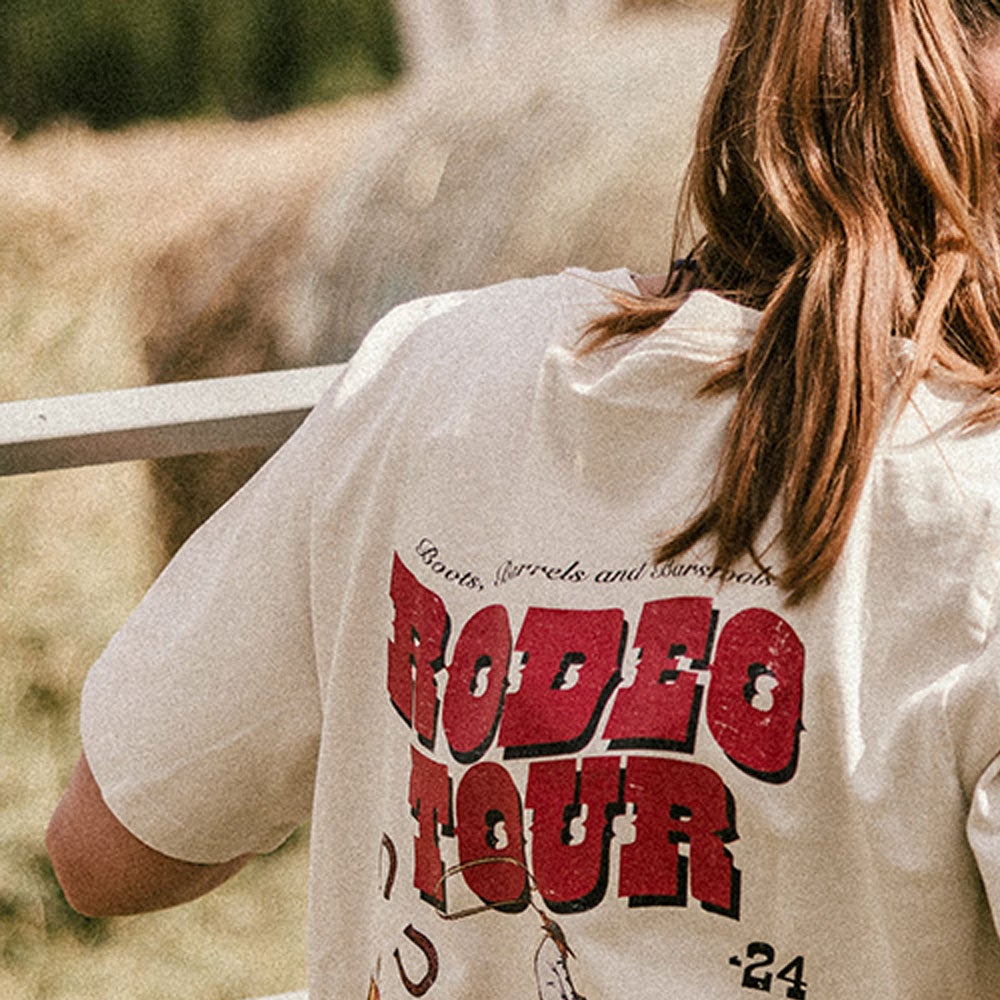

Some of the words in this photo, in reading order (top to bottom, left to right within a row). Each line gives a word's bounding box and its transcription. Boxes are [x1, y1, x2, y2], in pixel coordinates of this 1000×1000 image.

[415, 537, 484, 592] Boots,
[594, 562, 646, 583] and
[388, 551, 806, 785] RODEO
[409, 743, 741, 920] TOUR
